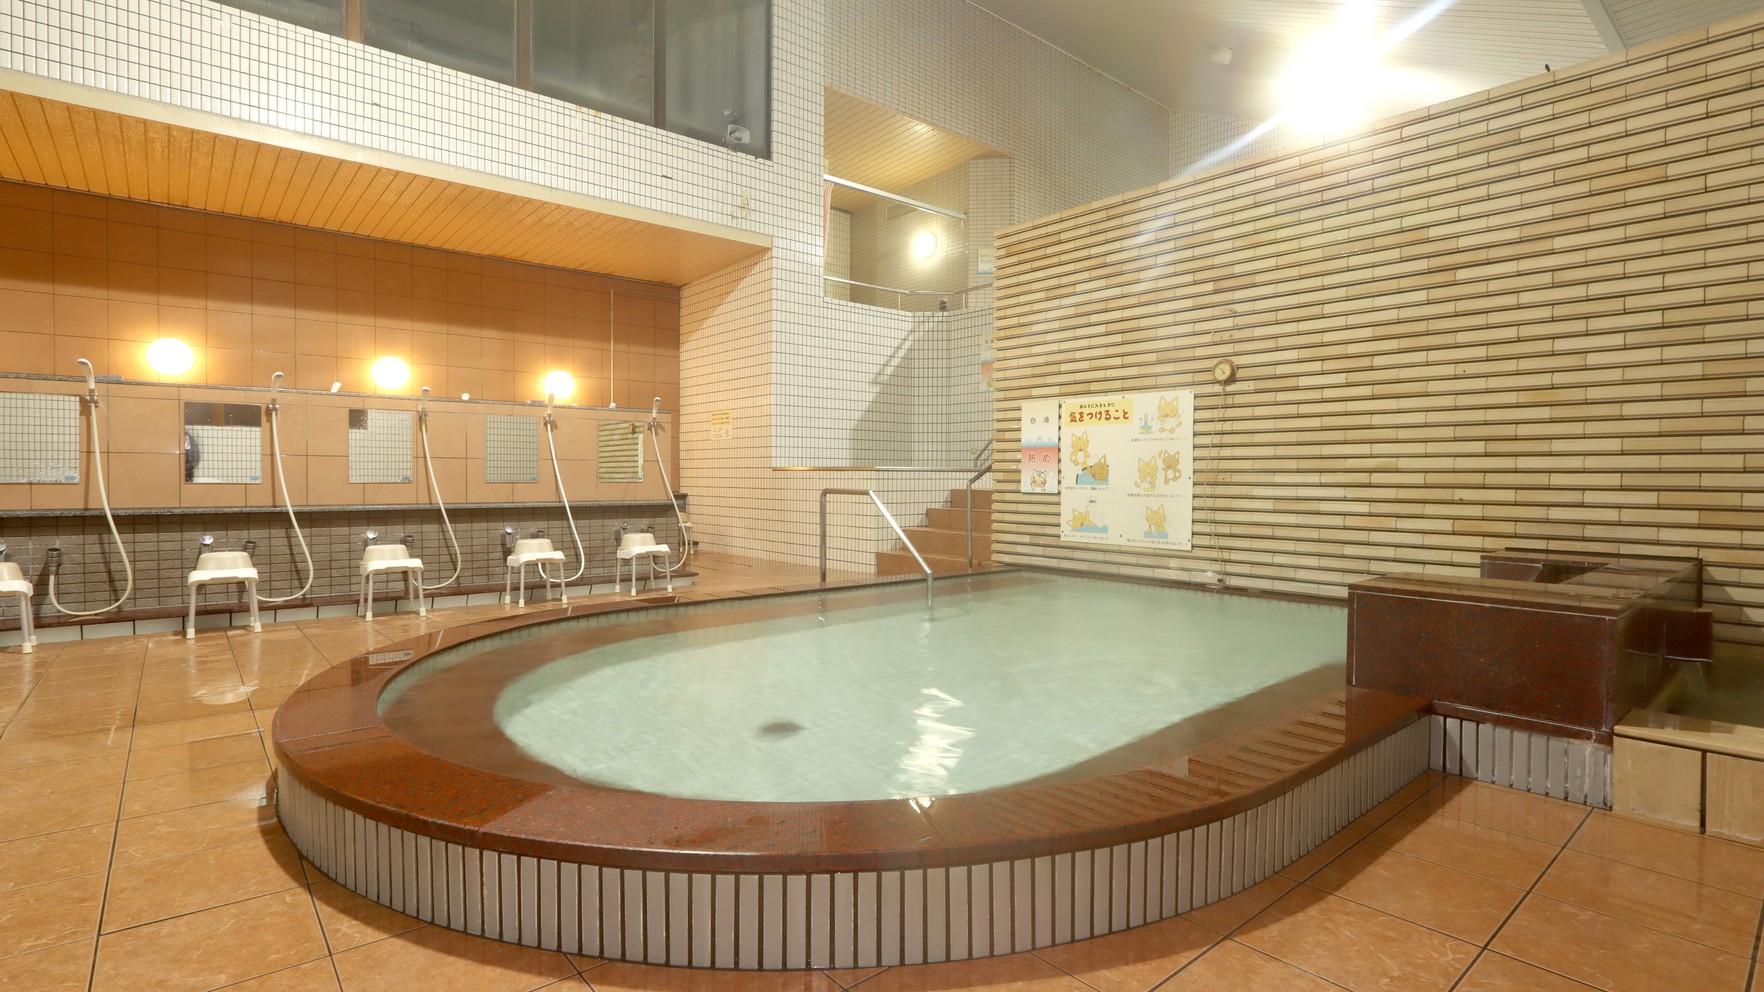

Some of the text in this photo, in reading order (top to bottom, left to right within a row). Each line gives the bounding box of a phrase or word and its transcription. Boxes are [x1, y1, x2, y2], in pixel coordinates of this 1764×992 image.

[1069, 409, 1130, 423] 気をつけること
[1027, 453, 1051, 464] 熱め
